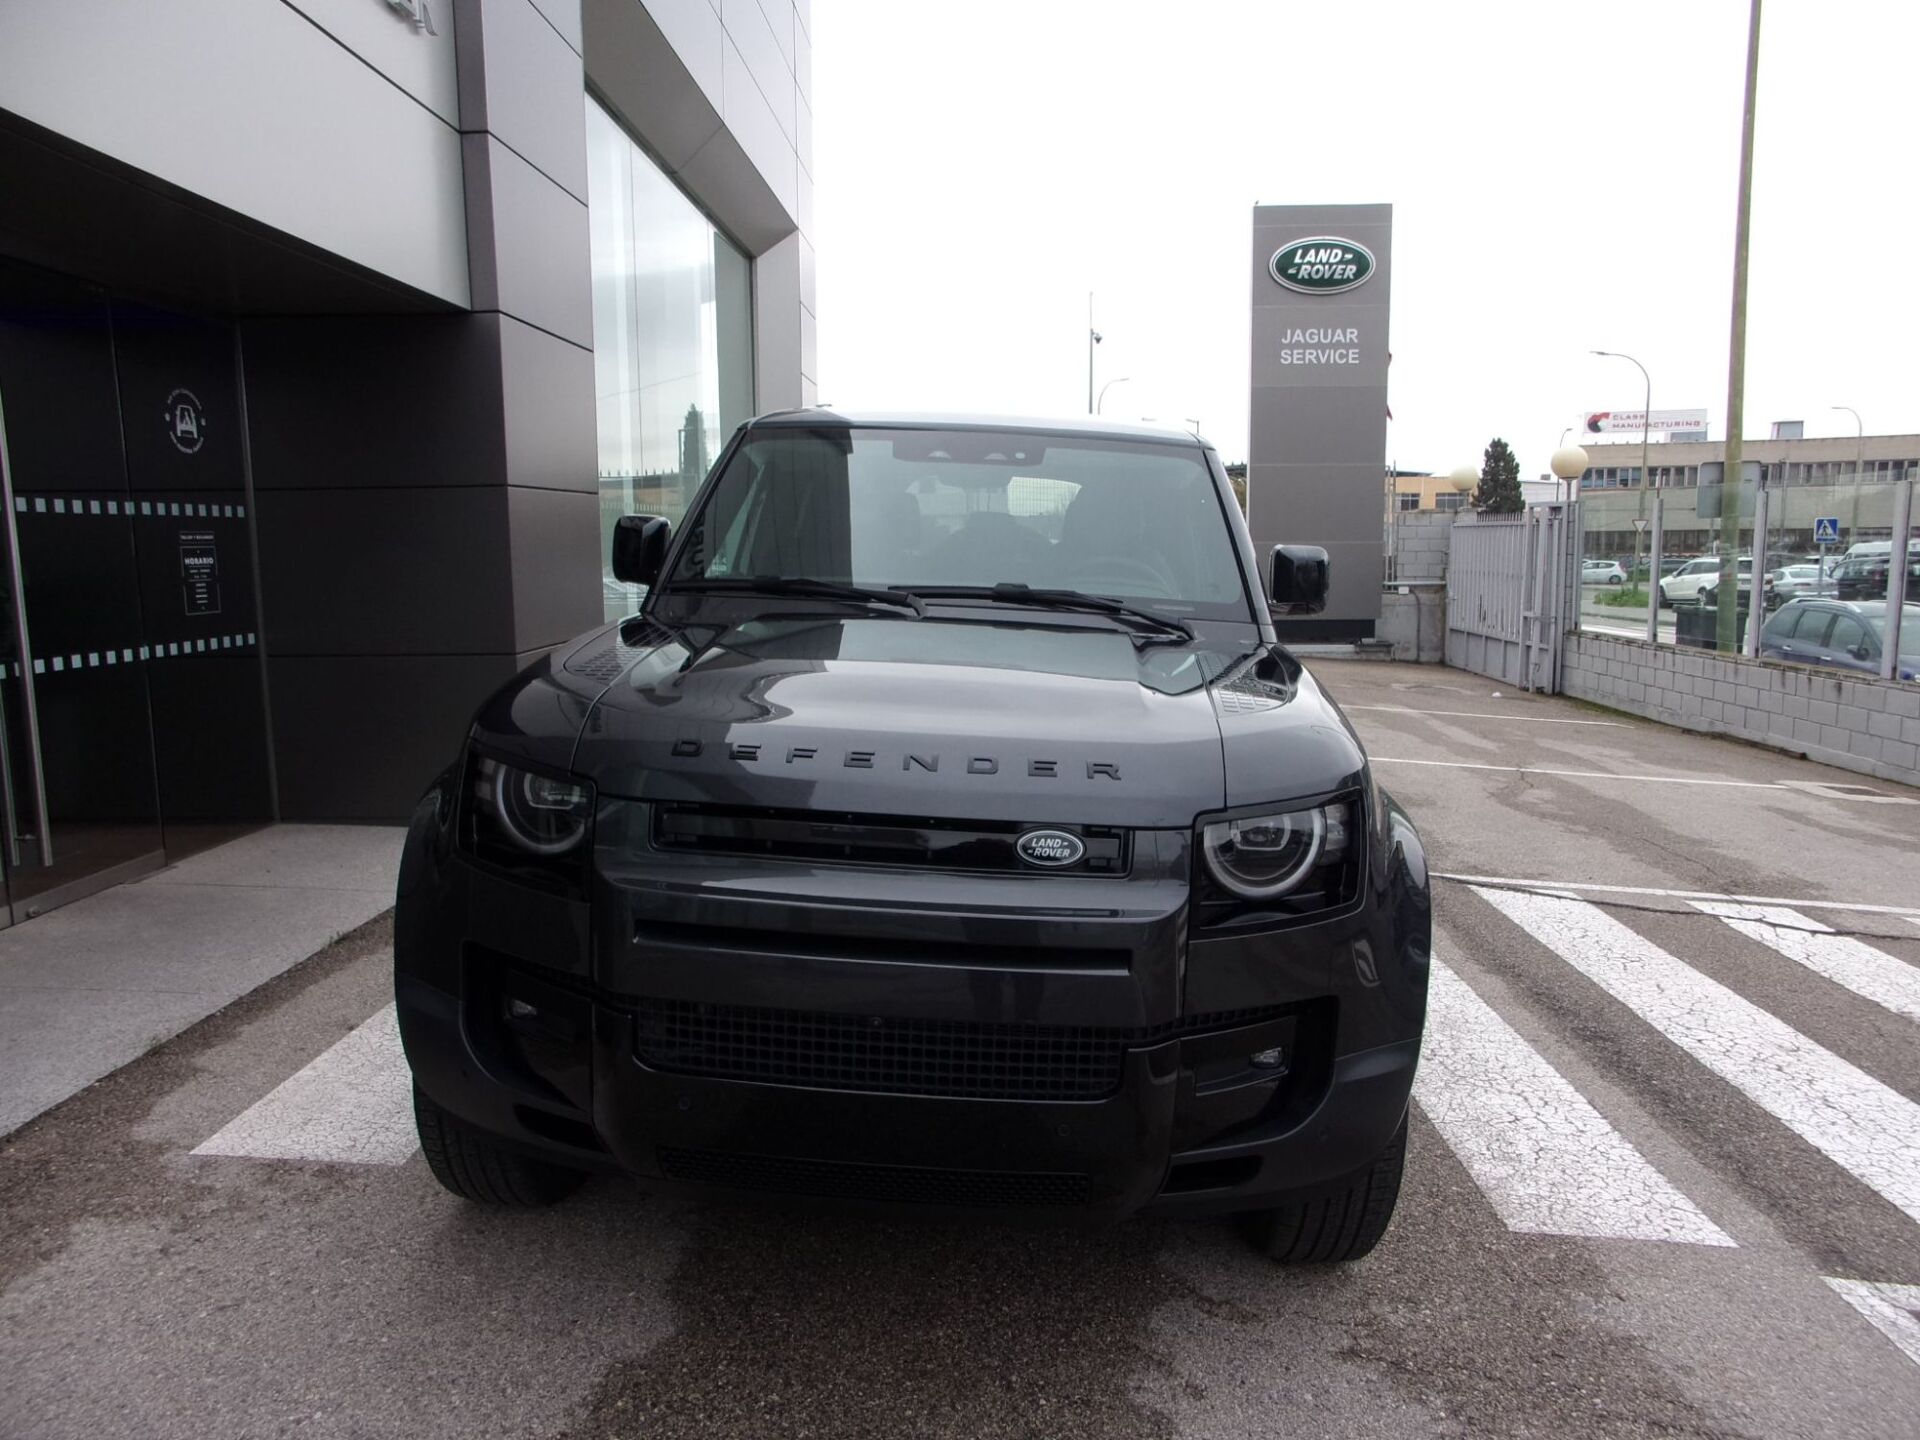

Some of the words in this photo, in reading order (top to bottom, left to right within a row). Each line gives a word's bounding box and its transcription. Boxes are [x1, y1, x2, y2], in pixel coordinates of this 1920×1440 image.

[1294, 248, 1343, 264] LAND
[1297, 264, 1357, 280] ROVER
[1281, 328, 1359, 344] JAGUAR
[1280, 349, 1361, 365] SERVICE
[184, 557, 214, 565] HORARIO
[671, 739, 1122, 781] DEFENDER
[1031, 838, 1062, 848] LAND
[1033, 847, 1071, 857] ROVER
